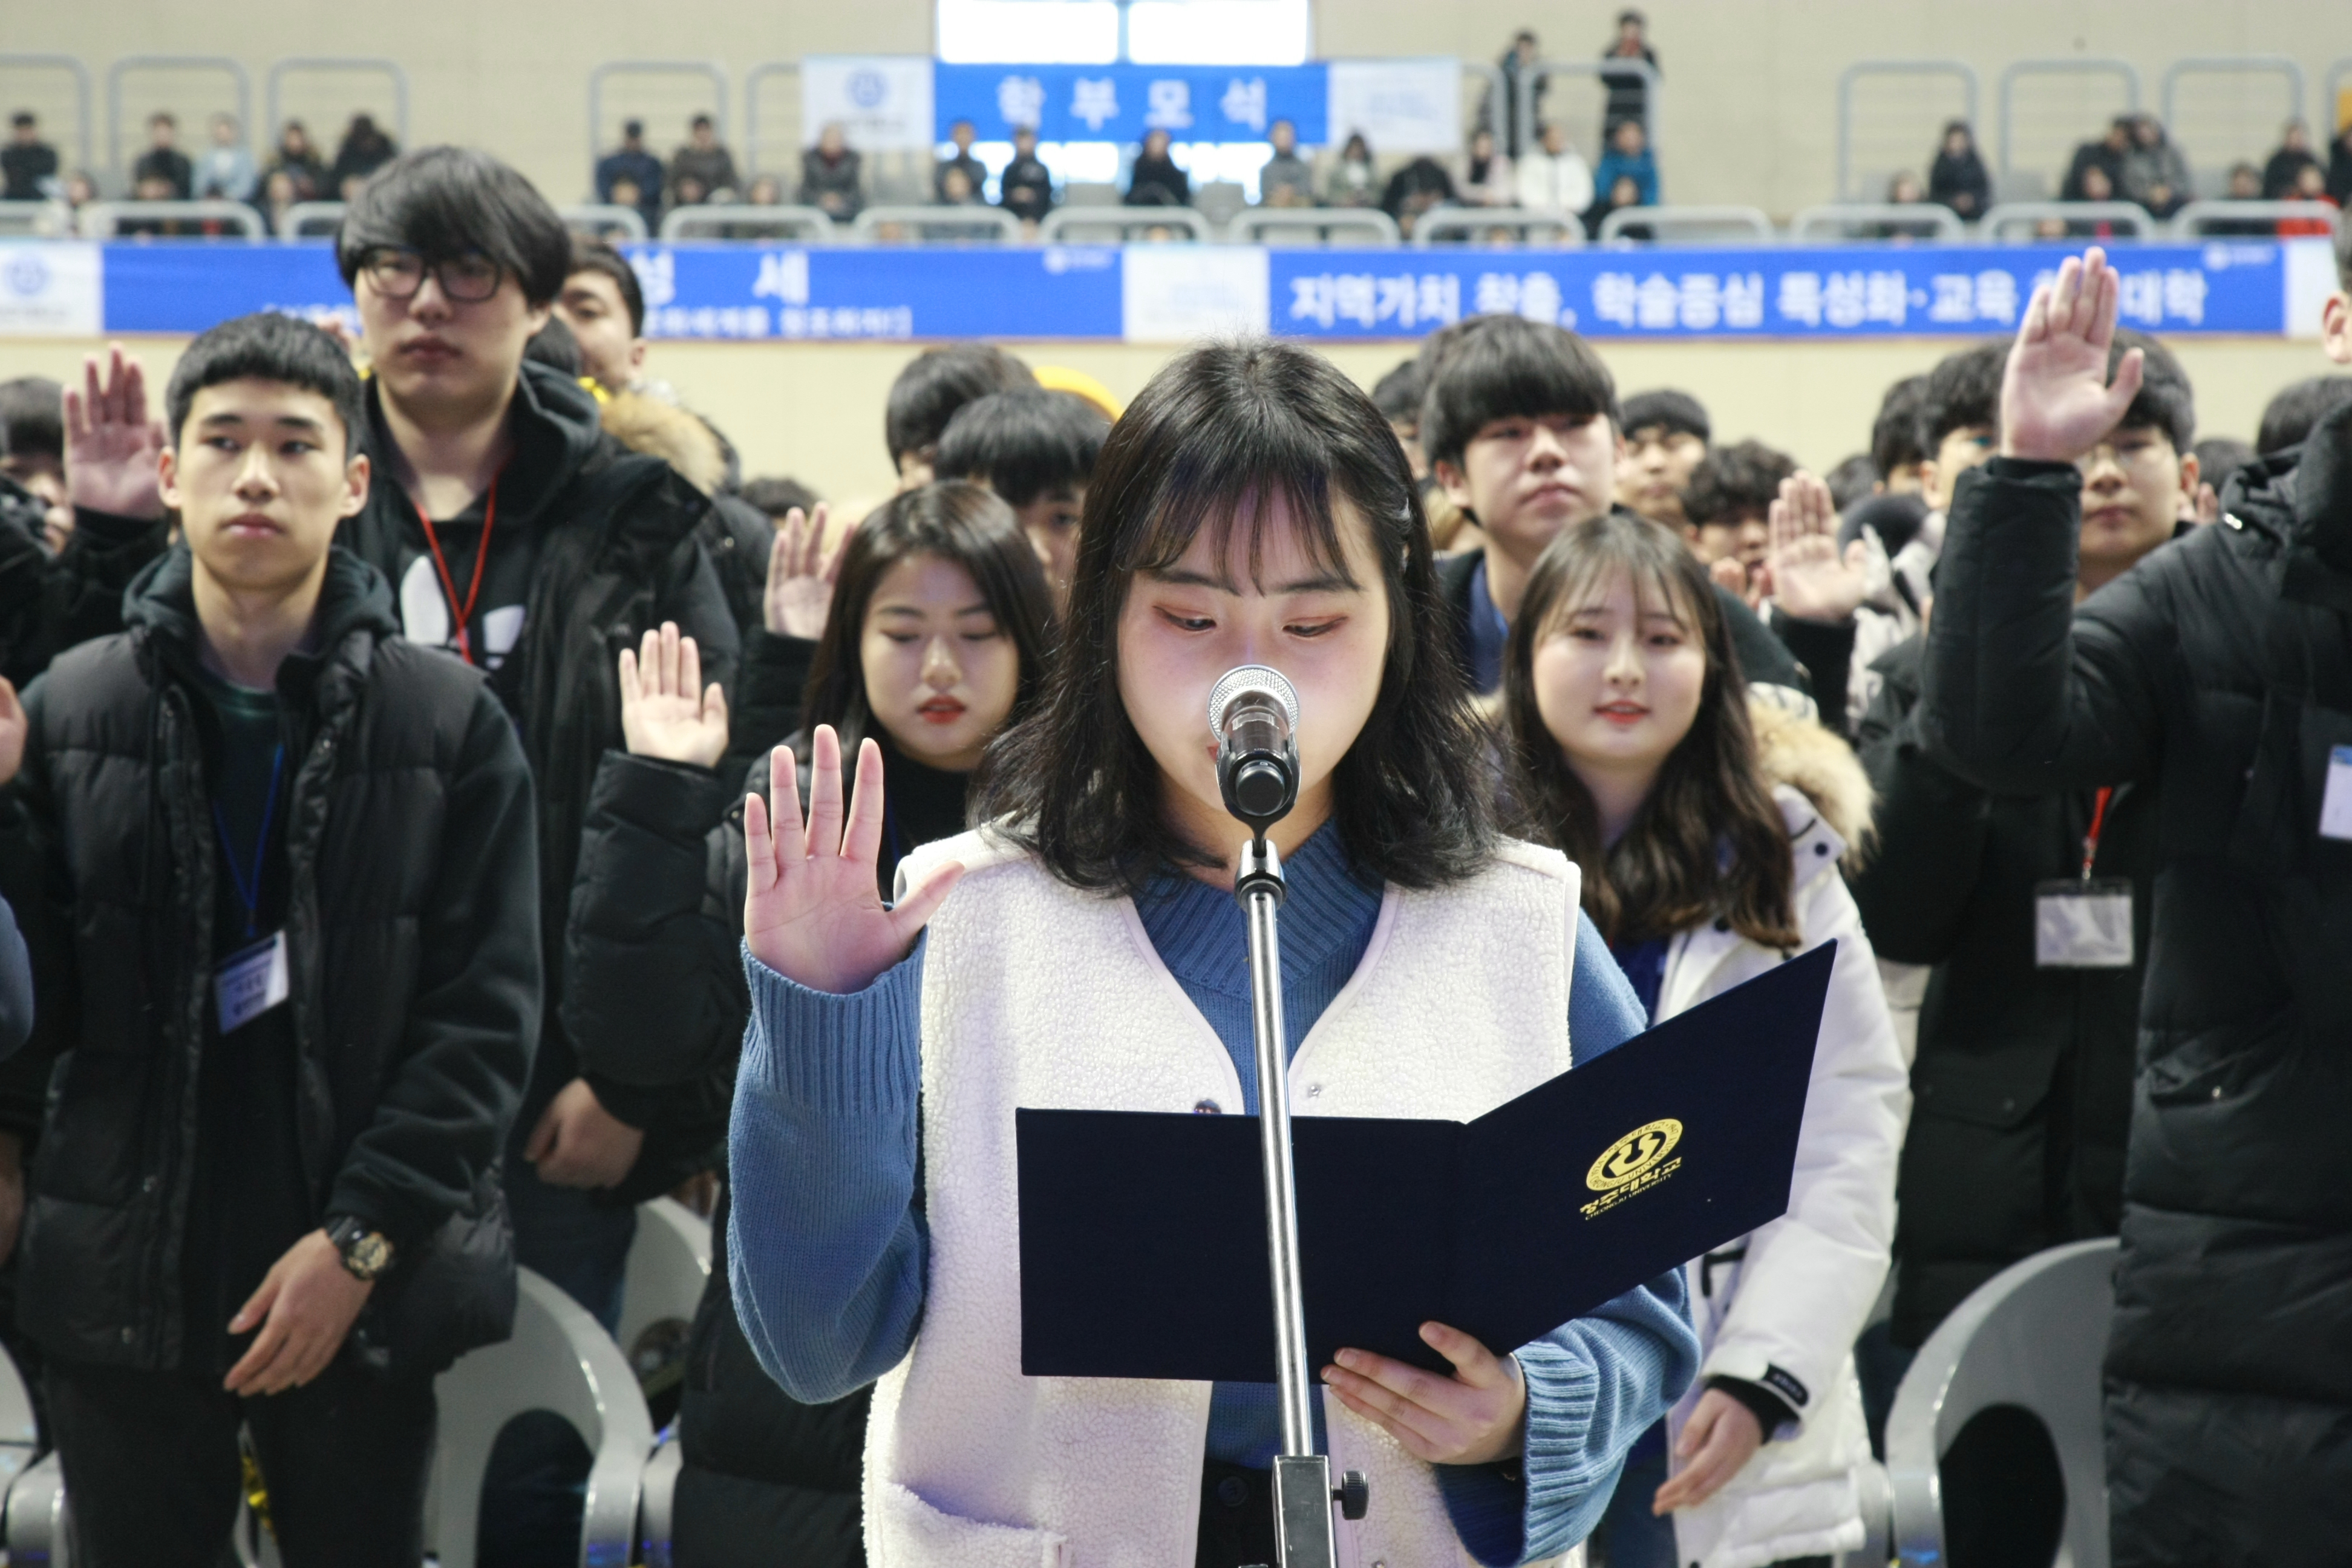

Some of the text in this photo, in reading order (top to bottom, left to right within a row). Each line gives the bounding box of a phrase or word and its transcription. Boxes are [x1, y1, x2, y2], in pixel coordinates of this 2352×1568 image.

[1579, 1156, 1682, 1215] 청주대학교
[1585, 1173, 1674, 1221] CHEONGJU UNIVERSITY
